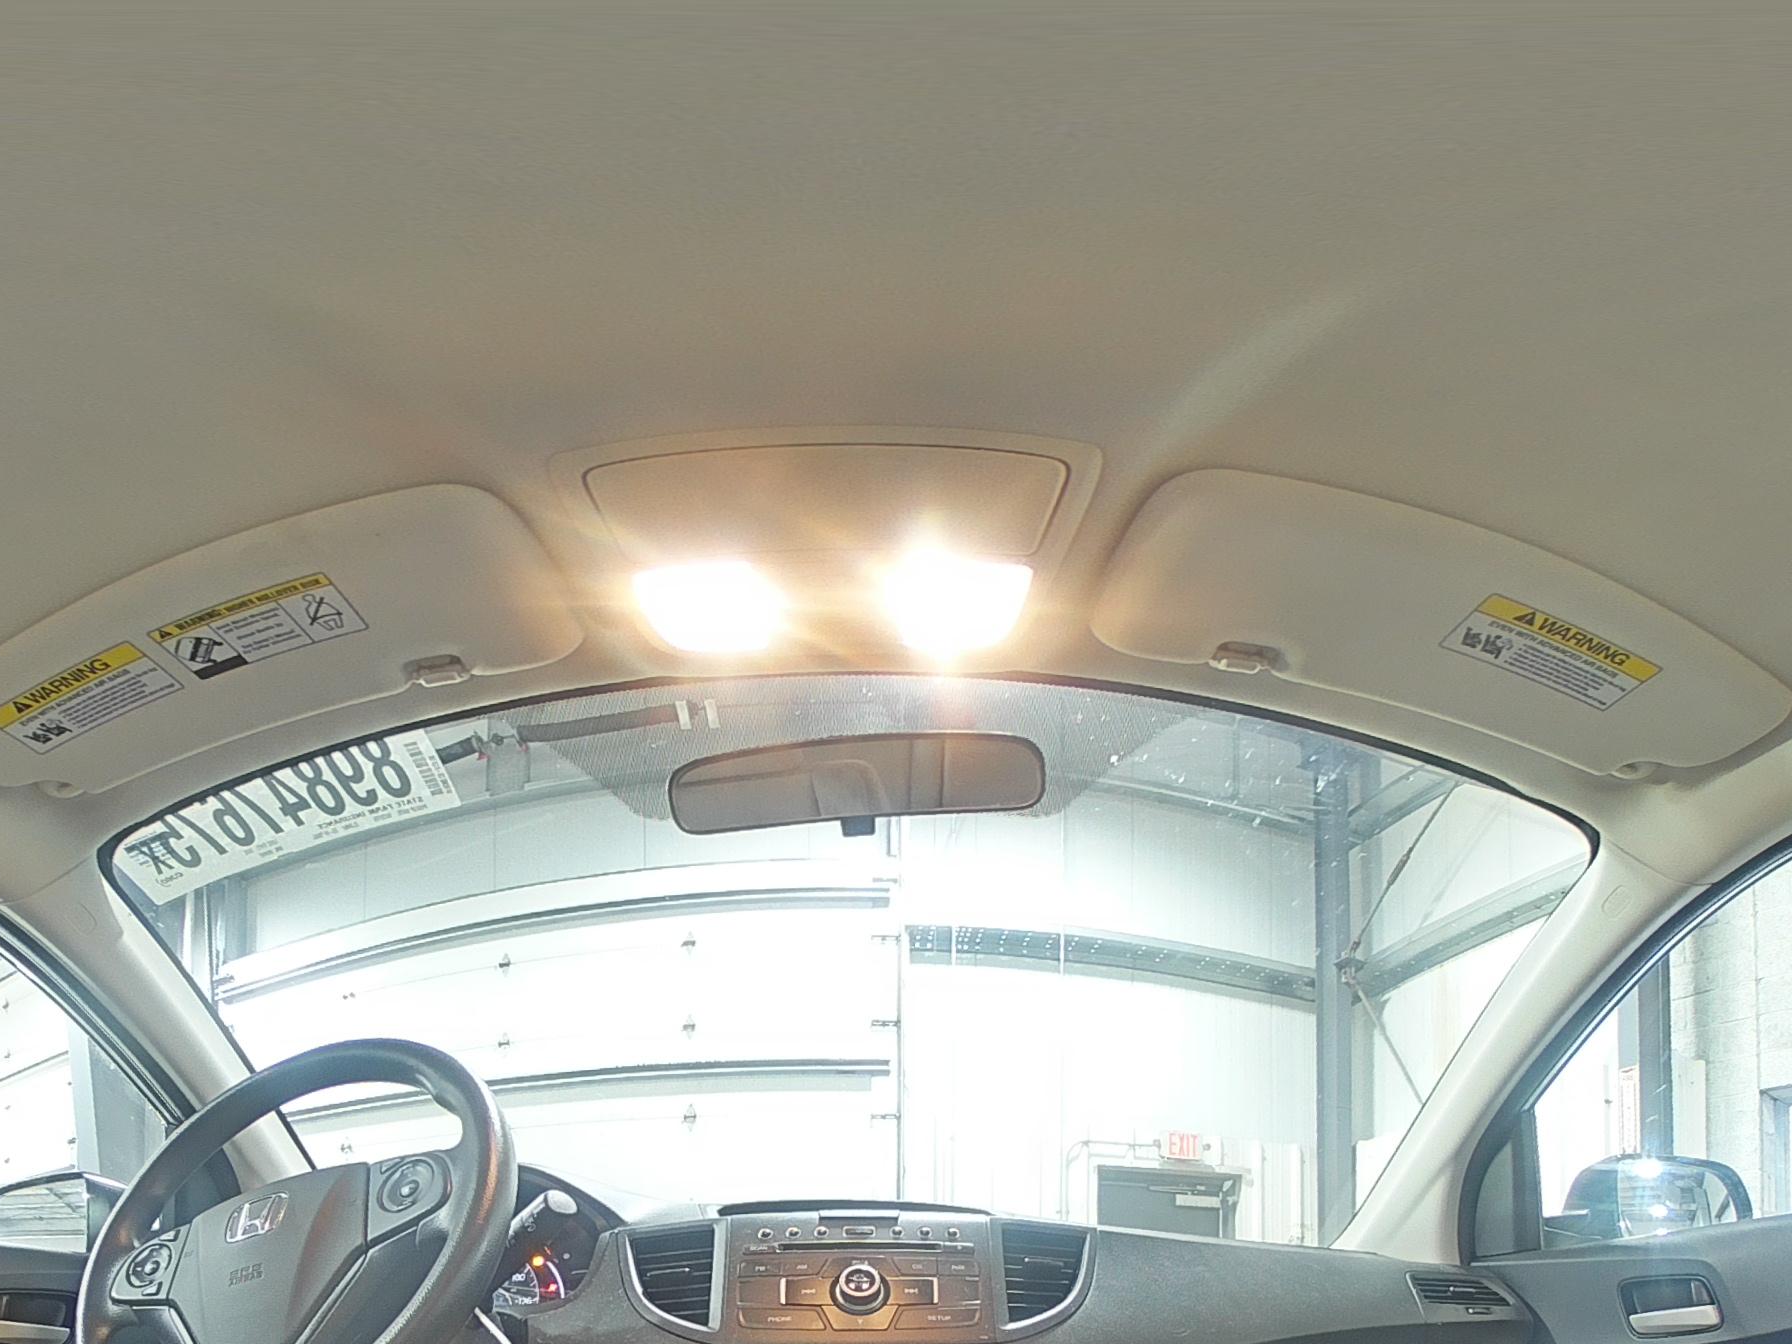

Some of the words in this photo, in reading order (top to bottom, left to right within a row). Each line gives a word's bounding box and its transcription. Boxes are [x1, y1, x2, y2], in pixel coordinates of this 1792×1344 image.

[1538, 617, 1631, 667] WARNING
[28, 659, 112, 704] WARNING
[1169, 1132, 1198, 1158] EXIT
